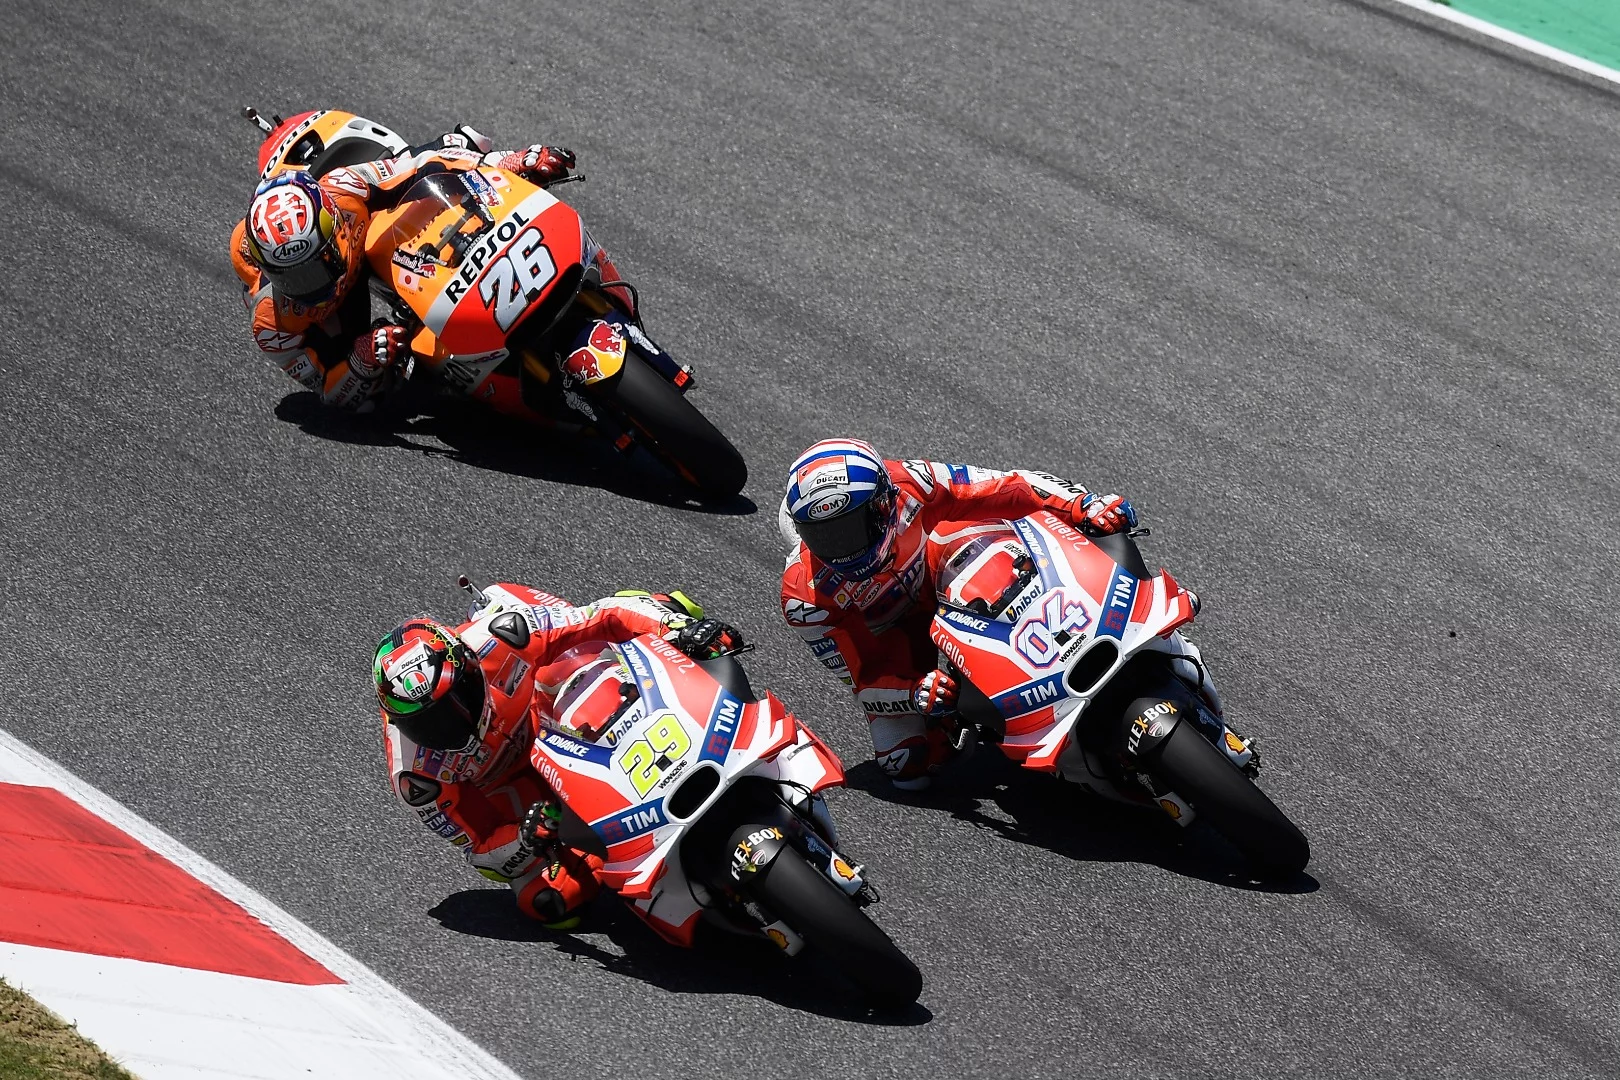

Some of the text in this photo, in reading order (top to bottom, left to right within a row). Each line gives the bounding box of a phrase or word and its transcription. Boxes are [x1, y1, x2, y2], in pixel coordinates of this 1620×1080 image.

[279, 241, 305, 256] Arai
[445, 212, 529, 304] REPSOL
[478, 226, 558, 334] 26
[288, 361, 308, 375] PSOL
[816, 475, 846, 485] DUCATI
[811, 497, 847, 515] SUOMY
[906, 503, 921, 523] DUCATI
[1005, 585, 1043, 622] Unibat
[1111, 574, 1134, 609] TIM
[945, 611, 989, 631] ADVANCE
[1015, 590, 1092, 669] 04
[401, 653, 424, 670] DUCATI
[1059, 633, 1087, 663] WDW2016
[515, 665, 528, 684] DUCATI
[1020, 681, 1058, 706] TIM
[606, 708, 642, 746] Unibat
[714, 699, 739, 733] TIM
[1127, 701, 1177, 756] FLEX-BOX
[545, 735, 590, 757] ADVANCE
[618, 714, 692, 800] 29
[658, 760, 687, 789] WDW2016
[621, 806, 660, 834] TIM
[731, 827, 783, 881] FLEX-BOX
